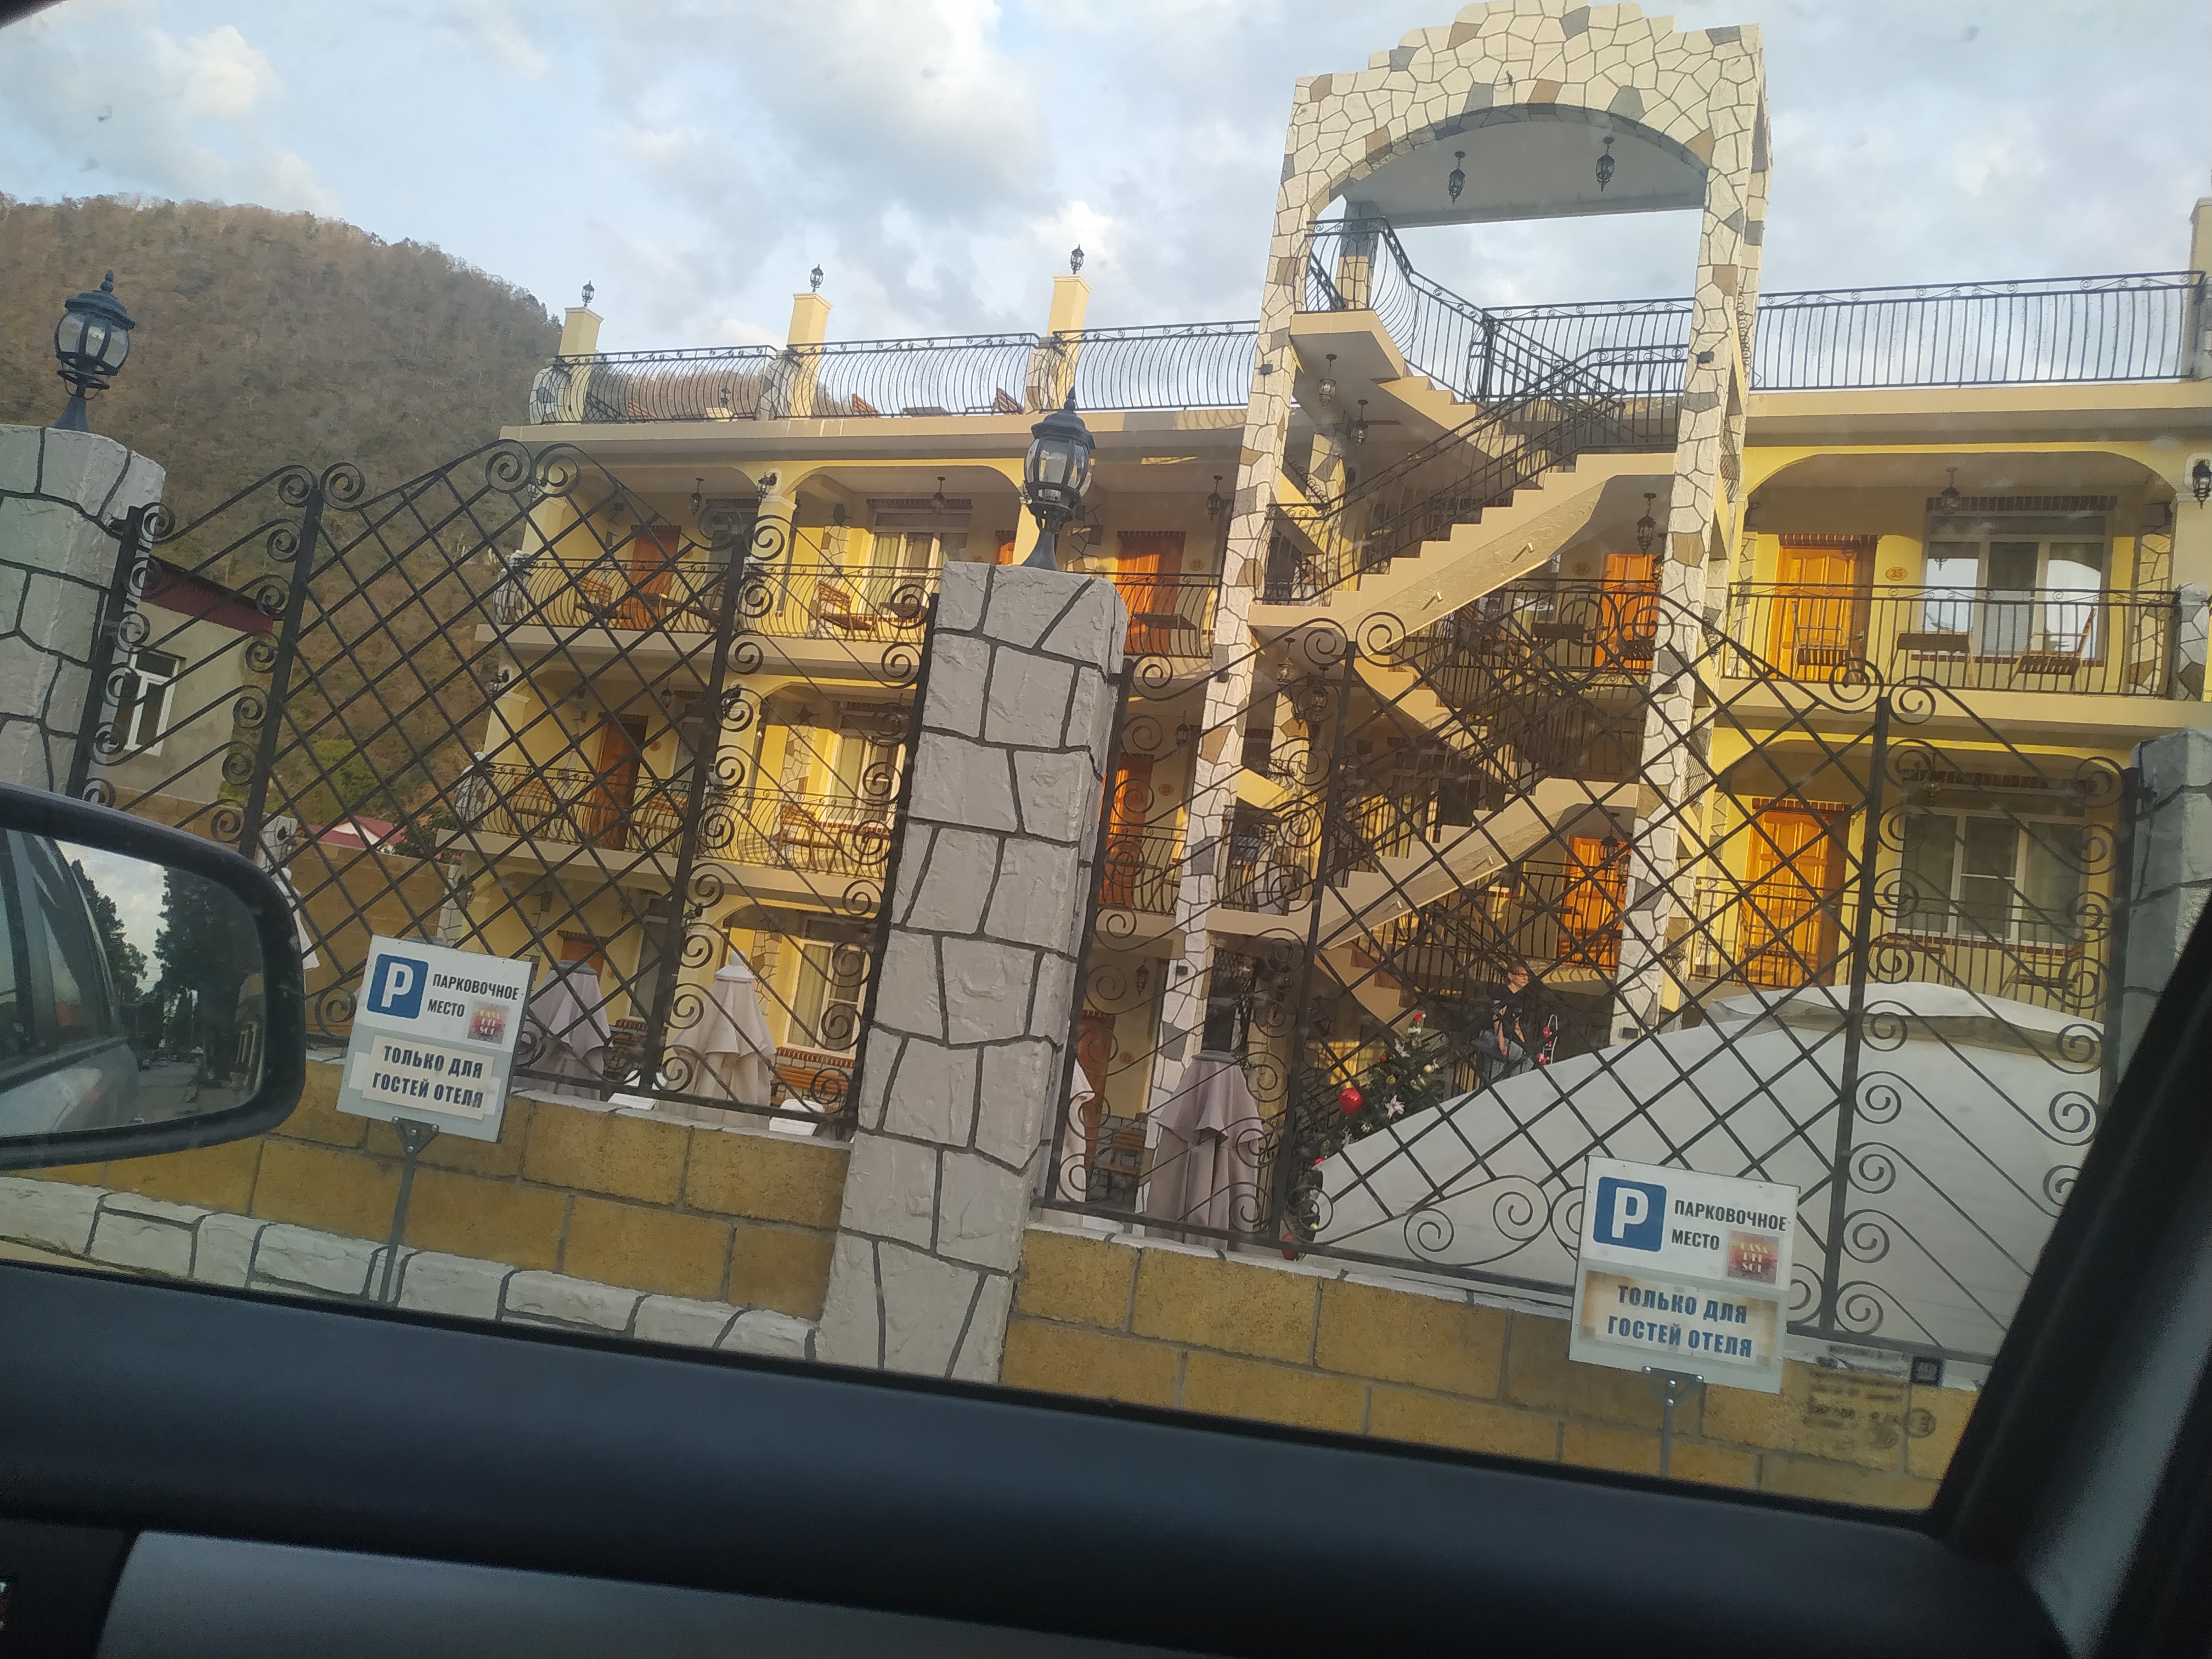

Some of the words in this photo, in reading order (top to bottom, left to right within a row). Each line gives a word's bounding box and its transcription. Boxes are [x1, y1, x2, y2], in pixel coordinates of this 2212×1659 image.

[1890, 568, 1903, 578] 35
[381, 961, 414, 1008] P
[432, 973, 520, 1001] ПАРКОВОЧНОЕ
[427, 998, 465, 1018] МЕСТО
[383, 1045, 445, 1072] ТОЛЬКО
[448, 1057, 483, 1079] ДЛЯ
[371, 1072, 430, 1098] ГОСТЕЙ
[433, 1084, 484, 1109] ОТЕЛЯ
[1611, 1187, 1649, 1239] P
[1674, 1199, 1788, 1232] ПАРКОВОЧНОЕ
[1671, 1228, 1720, 1251] МЕСТО
[1740, 1242, 1768, 1254] CASA
[1742, 1262, 1763, 1273] SOL
[1618, 1284, 1697, 1316] ТОЛЬКО
[1703, 1300, 1747, 1324] ДЛЯ
[1607, 1316, 1681, 1346] ГОСТЕЙ
[1688, 1329, 1752, 1358] ОТЕЛЯ
